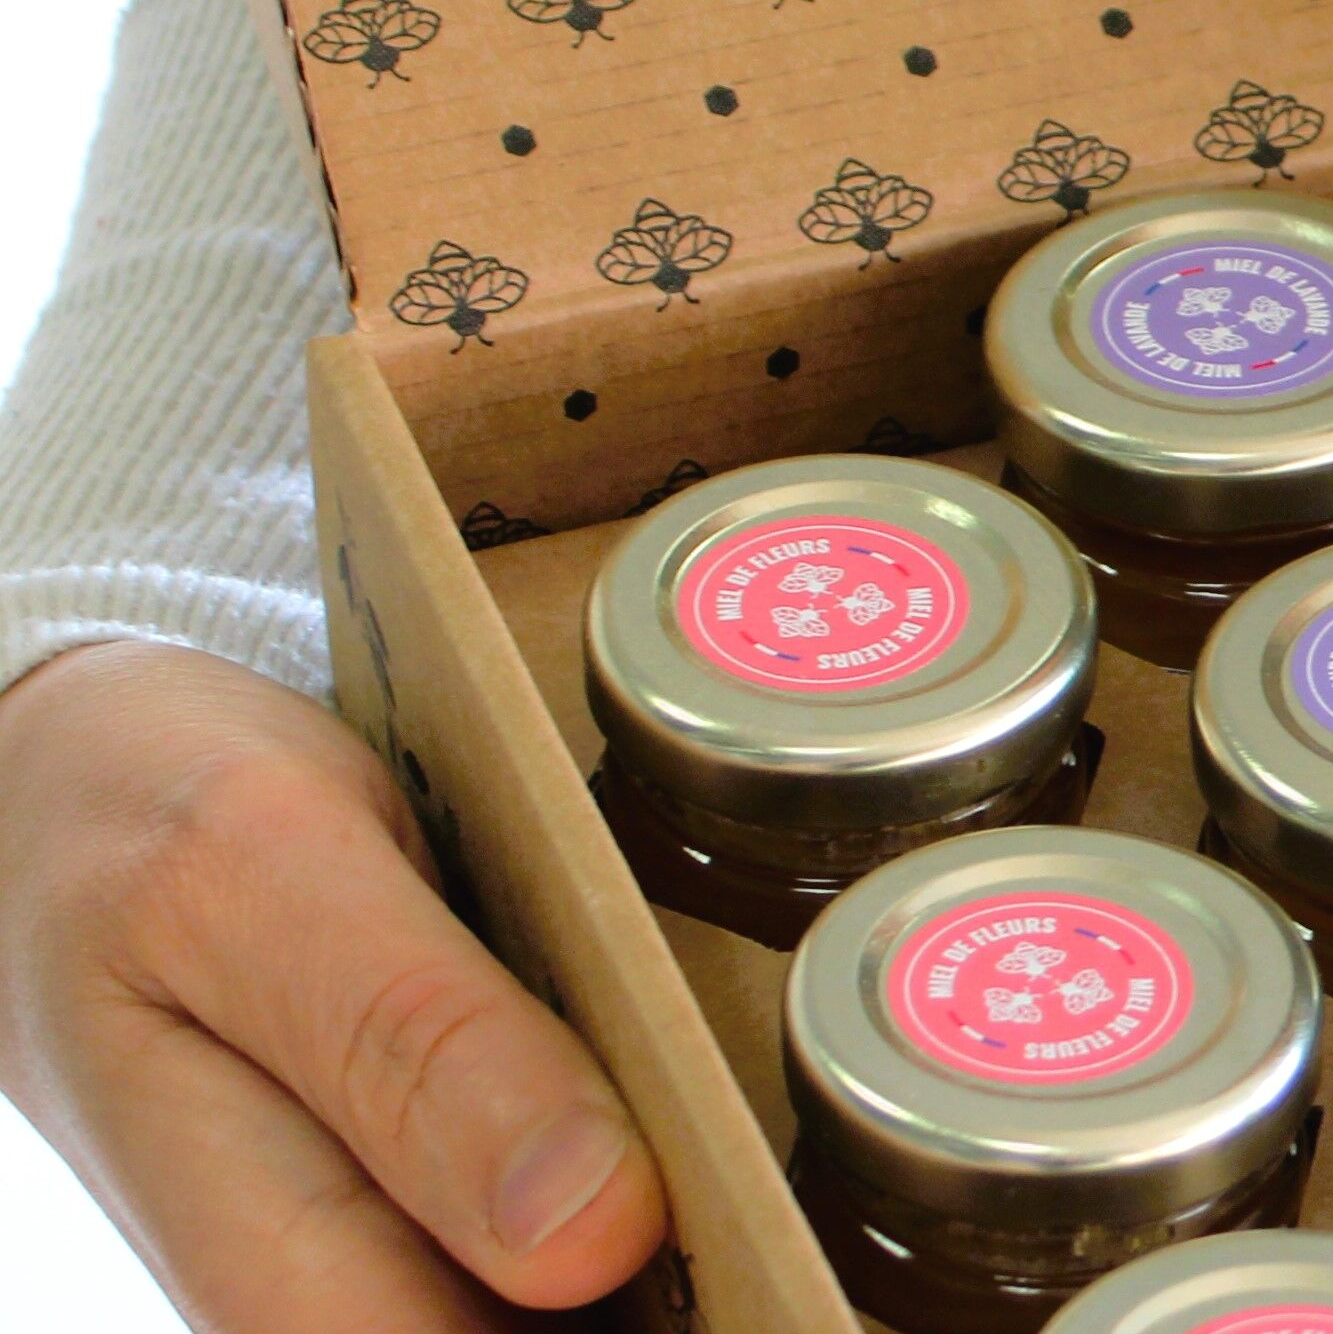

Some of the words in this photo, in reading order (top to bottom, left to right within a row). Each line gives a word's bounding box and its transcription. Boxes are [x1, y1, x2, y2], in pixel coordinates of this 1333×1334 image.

[1213, 258, 1263, 276] MIEL
[1265, 265, 1289, 284] DE
[1287, 279, 1332, 336] LAVANDE
[1122, 301, 1165, 358] LAVANDE
[1157, 350, 1190, 372] DE
[1192, 361, 1243, 379] MIEL
[748, 539, 831, 571] FLEURS
[726, 566, 759, 588] DE
[716, 587, 743, 621] MIEL
[906, 587, 933, 619] MIEL
[890, 622, 925, 644] DE
[817, 637, 902, 670] FLEURS
[969, 917, 1058, 946] FLEURS
[942, 940, 977, 963] DE
[928, 965, 959, 999] MIEL
[1123, 977, 1156, 1013] MIEL
[1105, 1013, 1141, 1037] DE
[1023, 1030, 1113, 1061] FLEURS
